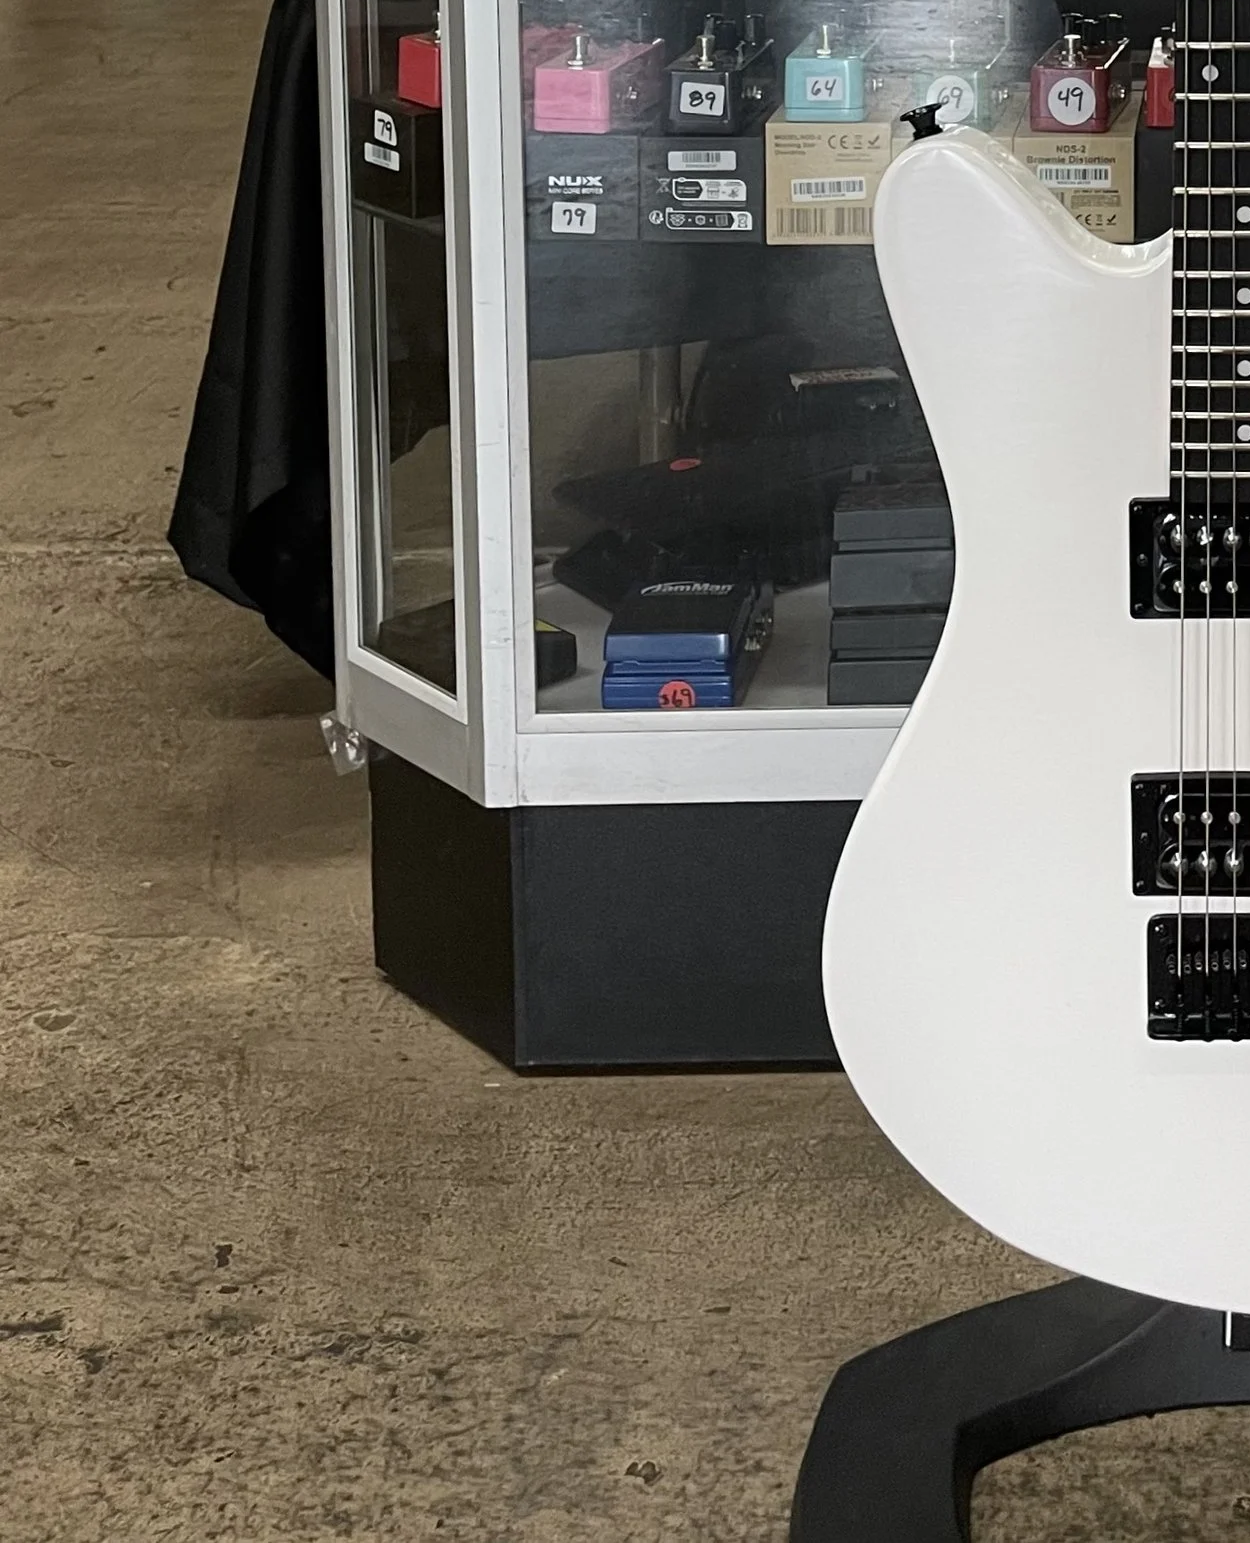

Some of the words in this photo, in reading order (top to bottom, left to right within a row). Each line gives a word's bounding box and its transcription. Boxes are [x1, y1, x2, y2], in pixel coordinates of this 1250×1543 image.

[811, 78, 838, 97] 64
[937, 86, 964, 109] 69
[689, 90, 717, 111] 89
[1057, 86, 1084, 112] 49
[377, 117, 393, 142] 79
[1056, 144, 1087, 154] NDS-2
[1068, 155, 1117, 165] Distortion
[548, 175, 603, 187] NUX
[562, 207, 587, 228] 79
[640, 580, 735, 596] JamMan
